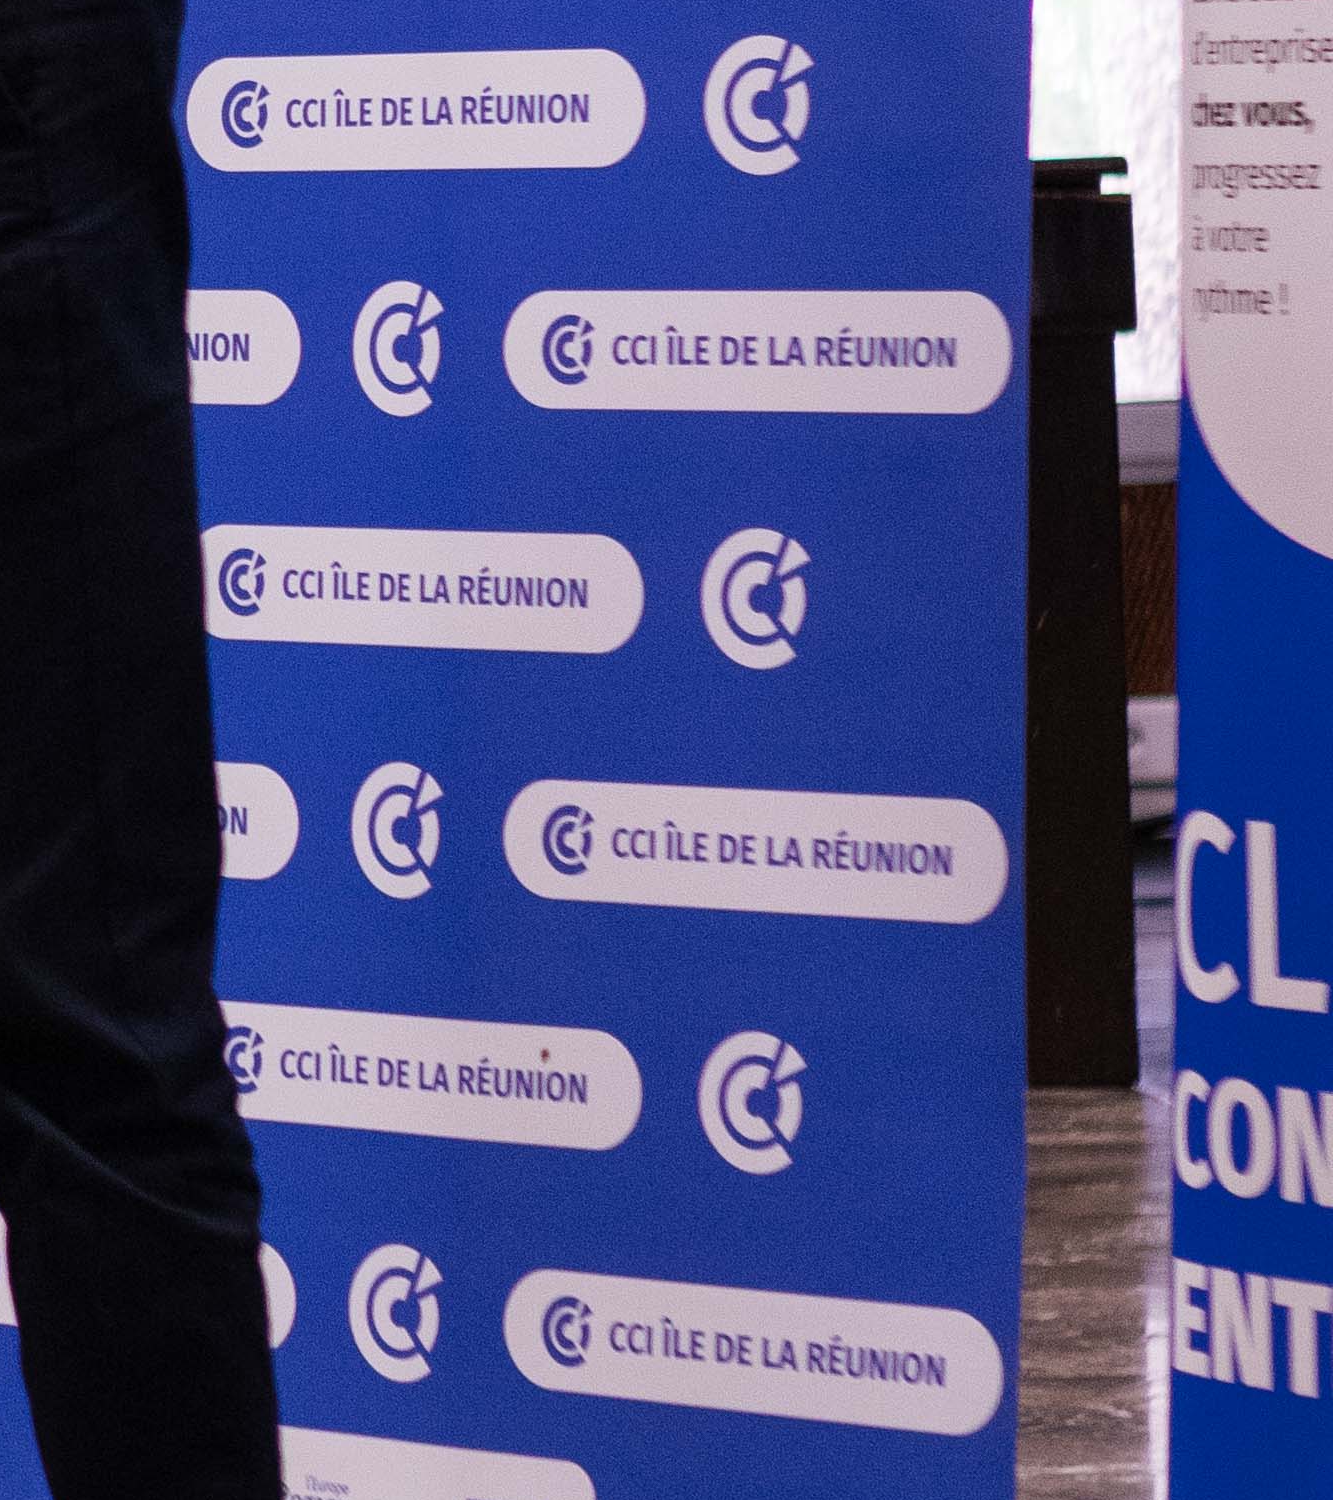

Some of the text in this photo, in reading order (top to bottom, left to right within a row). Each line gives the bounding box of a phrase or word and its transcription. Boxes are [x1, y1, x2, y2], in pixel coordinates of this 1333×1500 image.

[286, 87, 589, 128] CCI ÎLE DE LA RÉUNION
[187, 332, 250, 362] NION
[612, 326, 956, 368] CCI ÎLE DE LA RÉUNION
[283, 562, 588, 608] CCI ÎLE DE LA RÉUNION
[612, 821, 952, 876] CCI ÎLE DE LA RÉUNION
[280, 1044, 587, 1103] CCI ÎLE DE LA RÉUNION
[609, 1317, 945, 1386] CCI ÎLE DE LA RÉUNION
